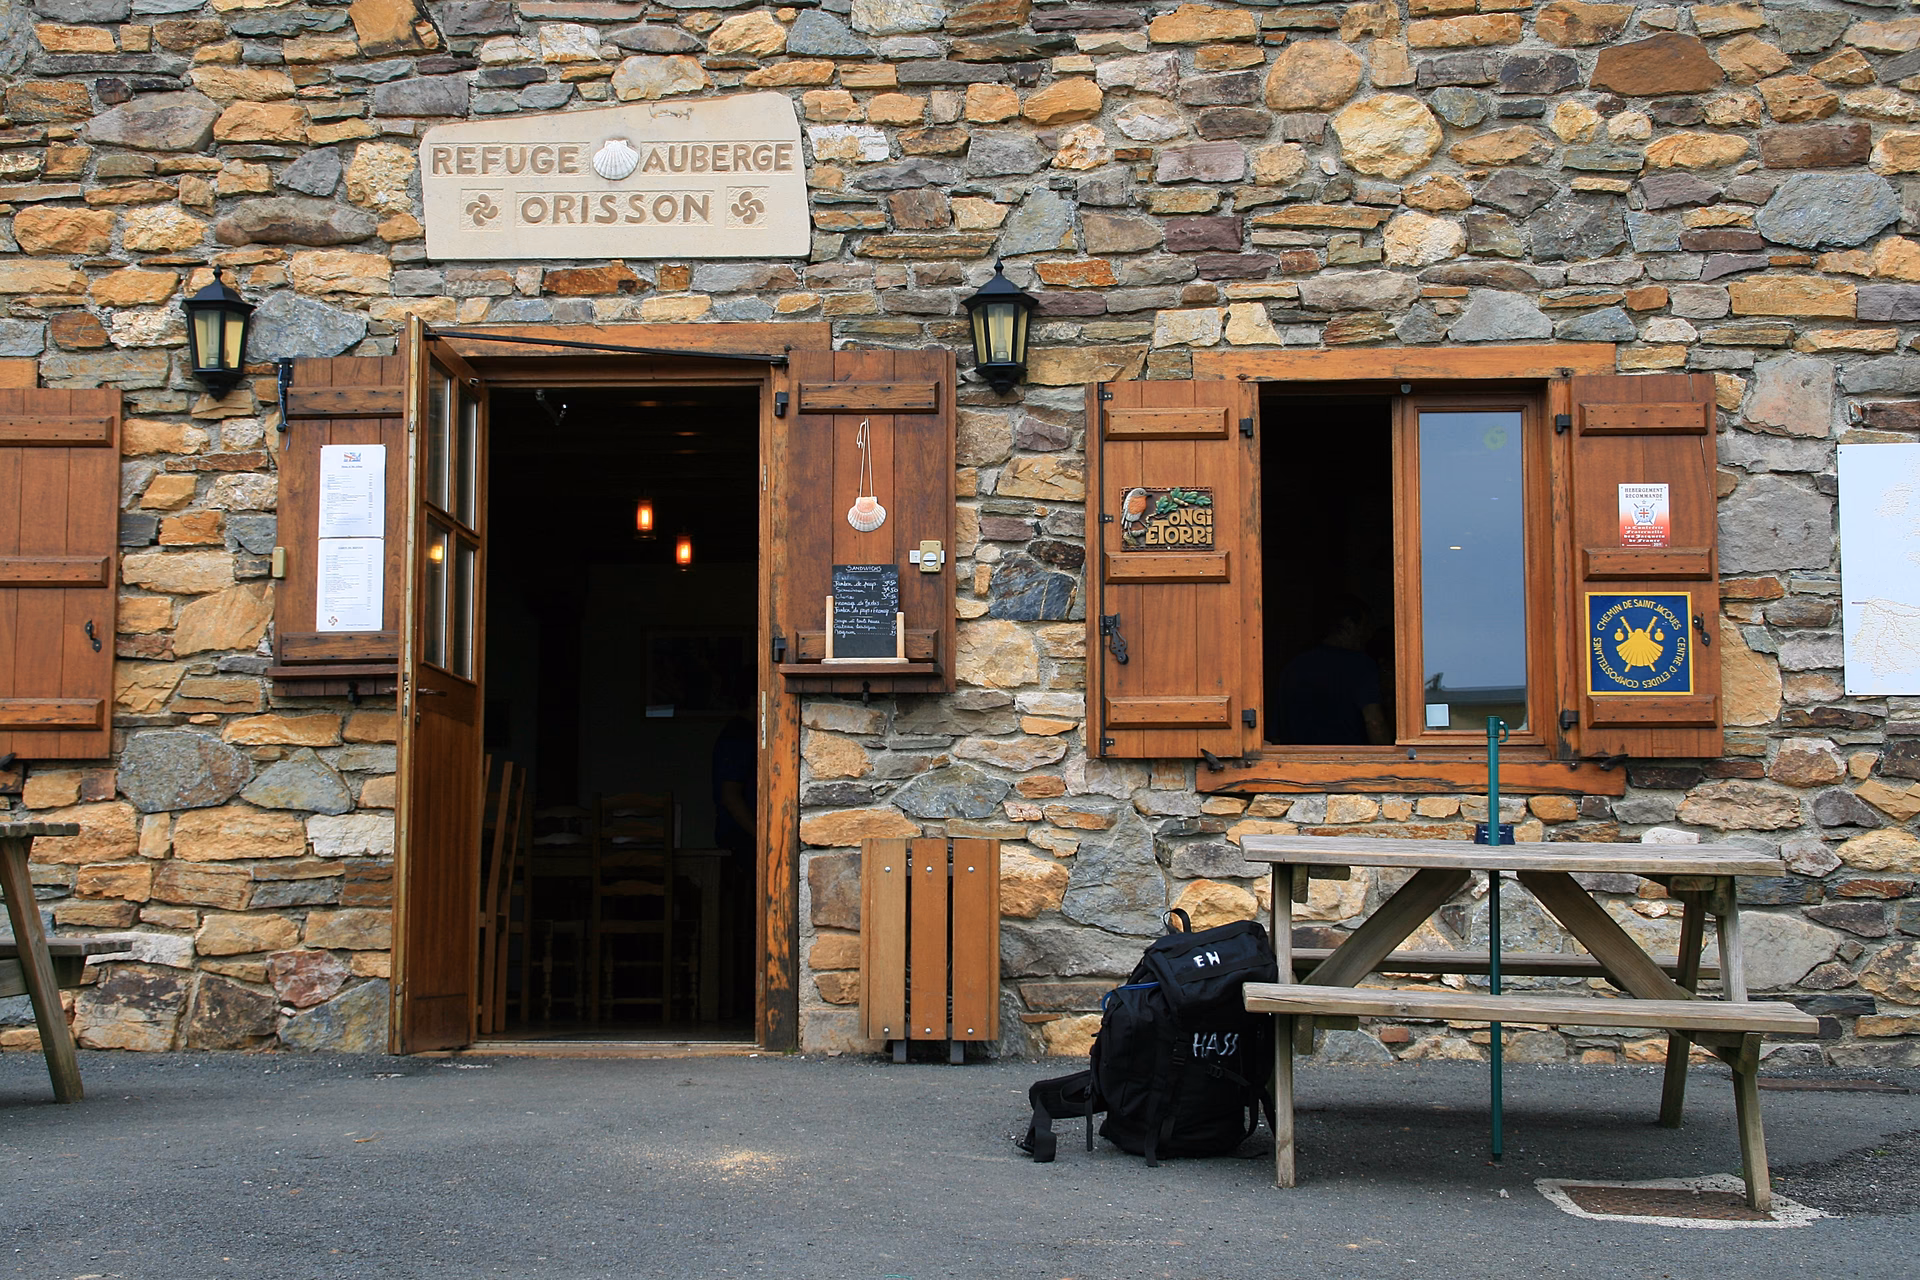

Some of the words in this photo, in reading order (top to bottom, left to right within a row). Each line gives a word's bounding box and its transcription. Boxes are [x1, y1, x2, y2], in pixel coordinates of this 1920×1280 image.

[432, 145, 579, 175] REFUGE
[641, 143, 793, 172] AUBERGE
[521, 193, 709, 224] ORISSON
[1596, 604, 1623, 631] CHEMIN
[1622, 599, 1633, 610] DE
[1633, 598, 1656, 609] SAINT
[1654, 604, 1682, 630] JACQUES
[1593, 637, 1639, 689] COMPOSTELLANES
[1672, 636, 1686, 667] CENTRE
[1192, 1032, 1239, 1058] HASS
